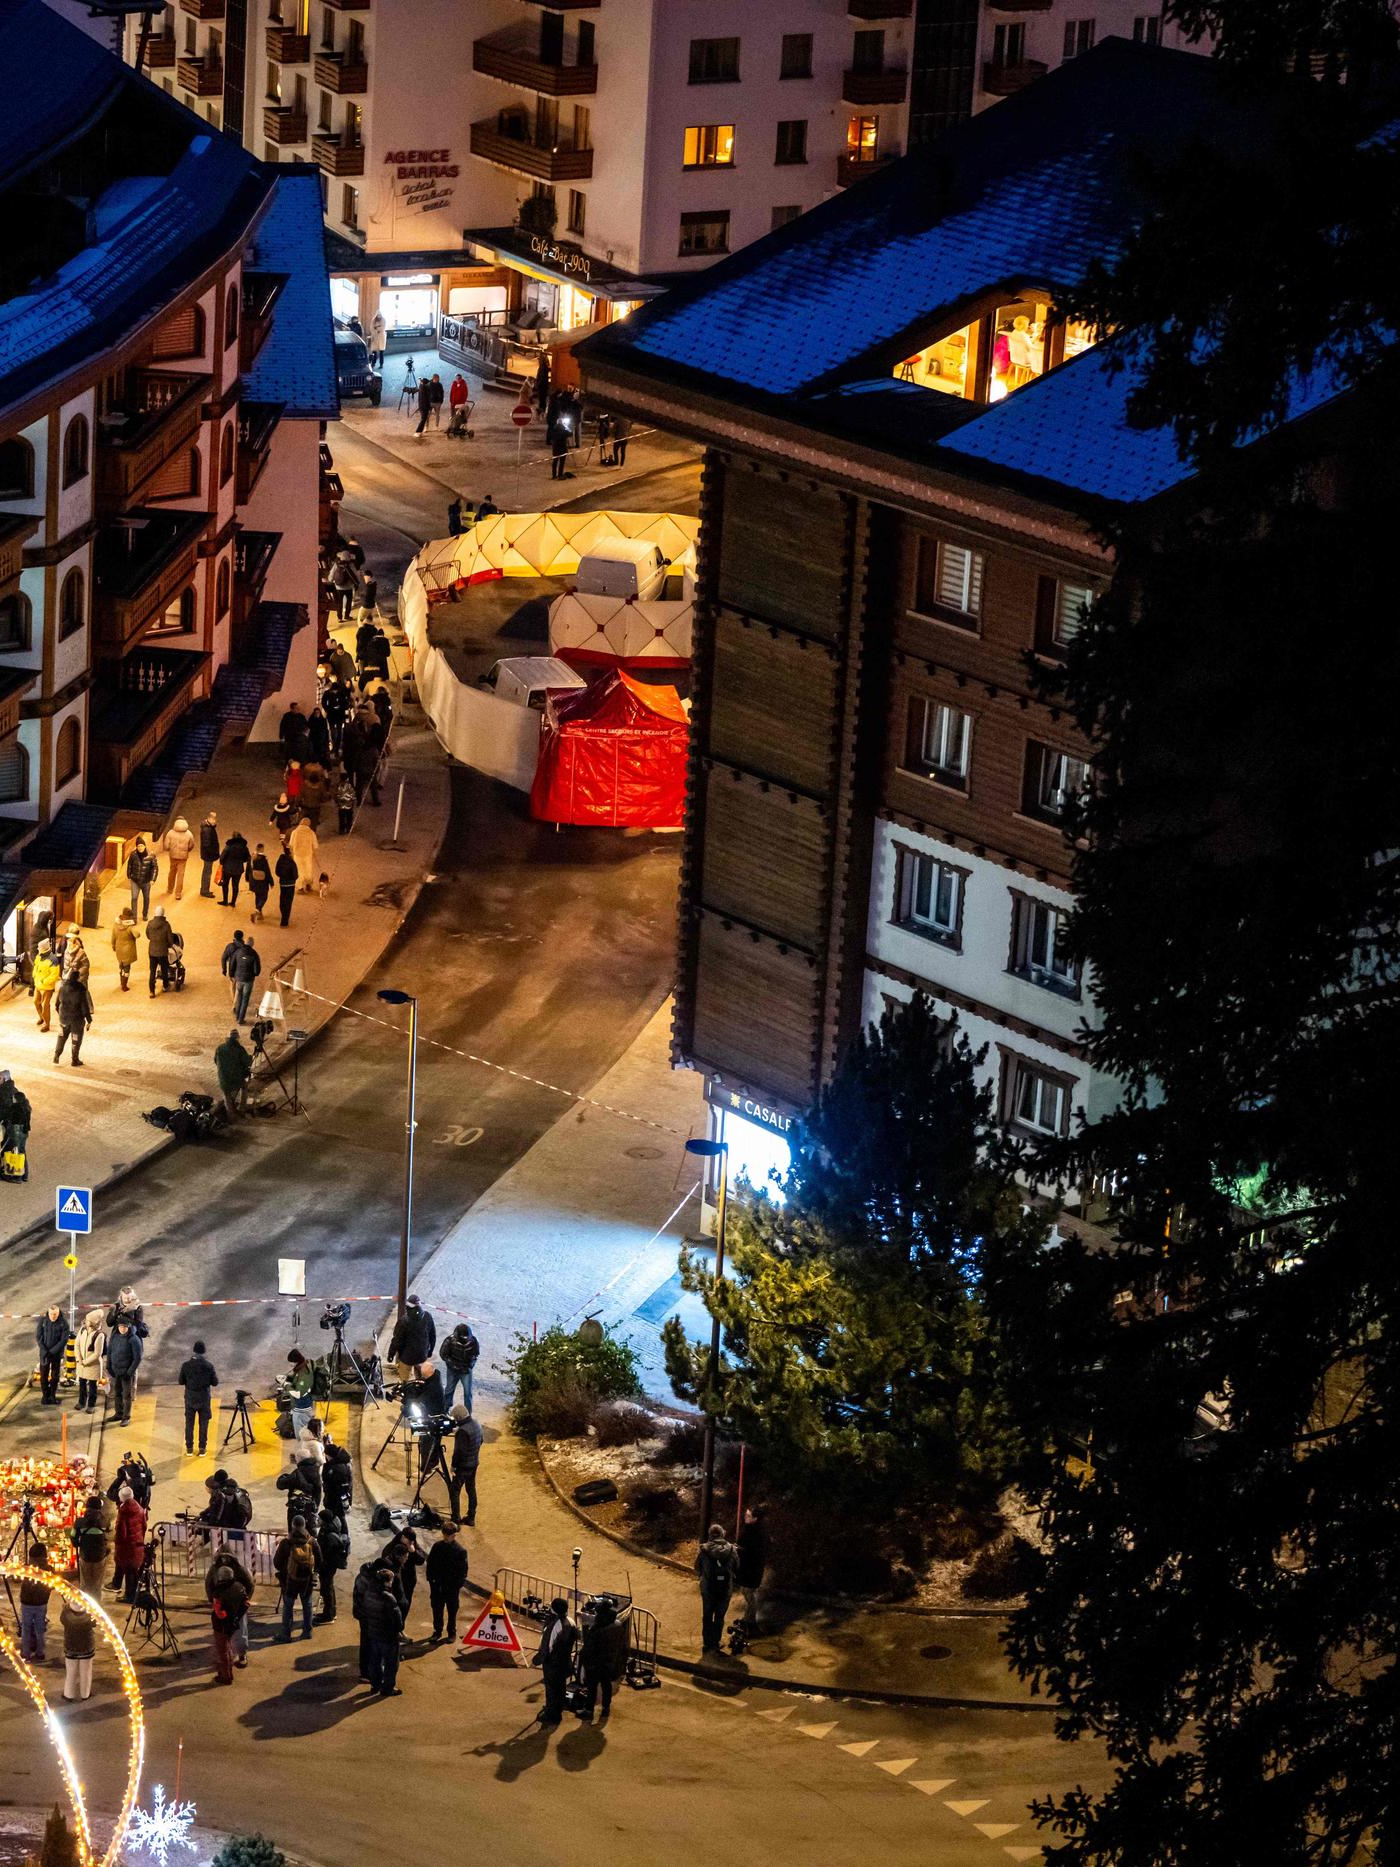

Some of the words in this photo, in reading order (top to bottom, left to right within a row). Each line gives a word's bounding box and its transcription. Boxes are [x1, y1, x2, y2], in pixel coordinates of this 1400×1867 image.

[384, 149, 450, 164] AGENCE
[397, 165, 459, 180] BARRAS
[432, 1125, 485, 1146] 30
[478, 1630, 509, 1642] Police
